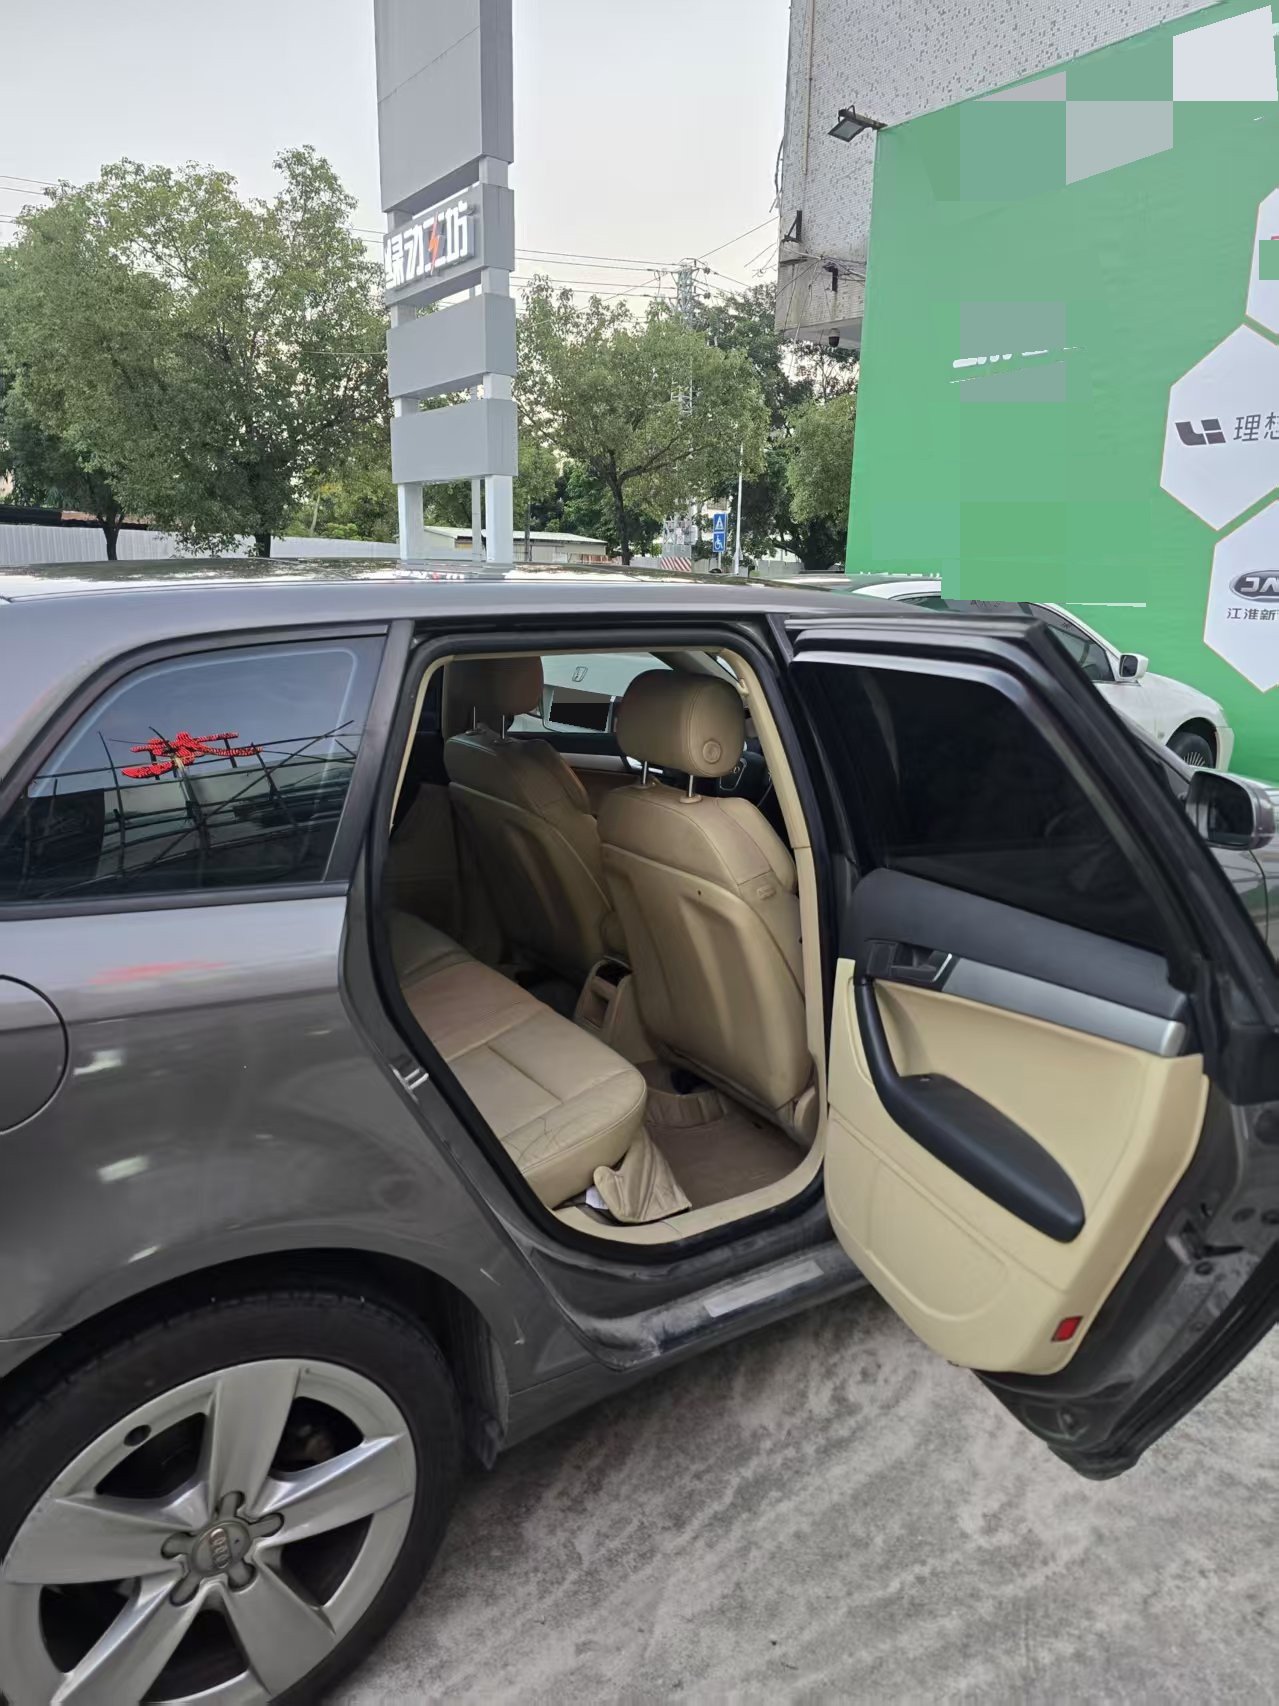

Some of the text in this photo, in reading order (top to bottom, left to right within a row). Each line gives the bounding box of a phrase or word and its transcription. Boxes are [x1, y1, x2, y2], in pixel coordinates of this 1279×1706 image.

[1240, 576, 1279, 593] JA
[1226, 607, 1279, 621] 江淮新
